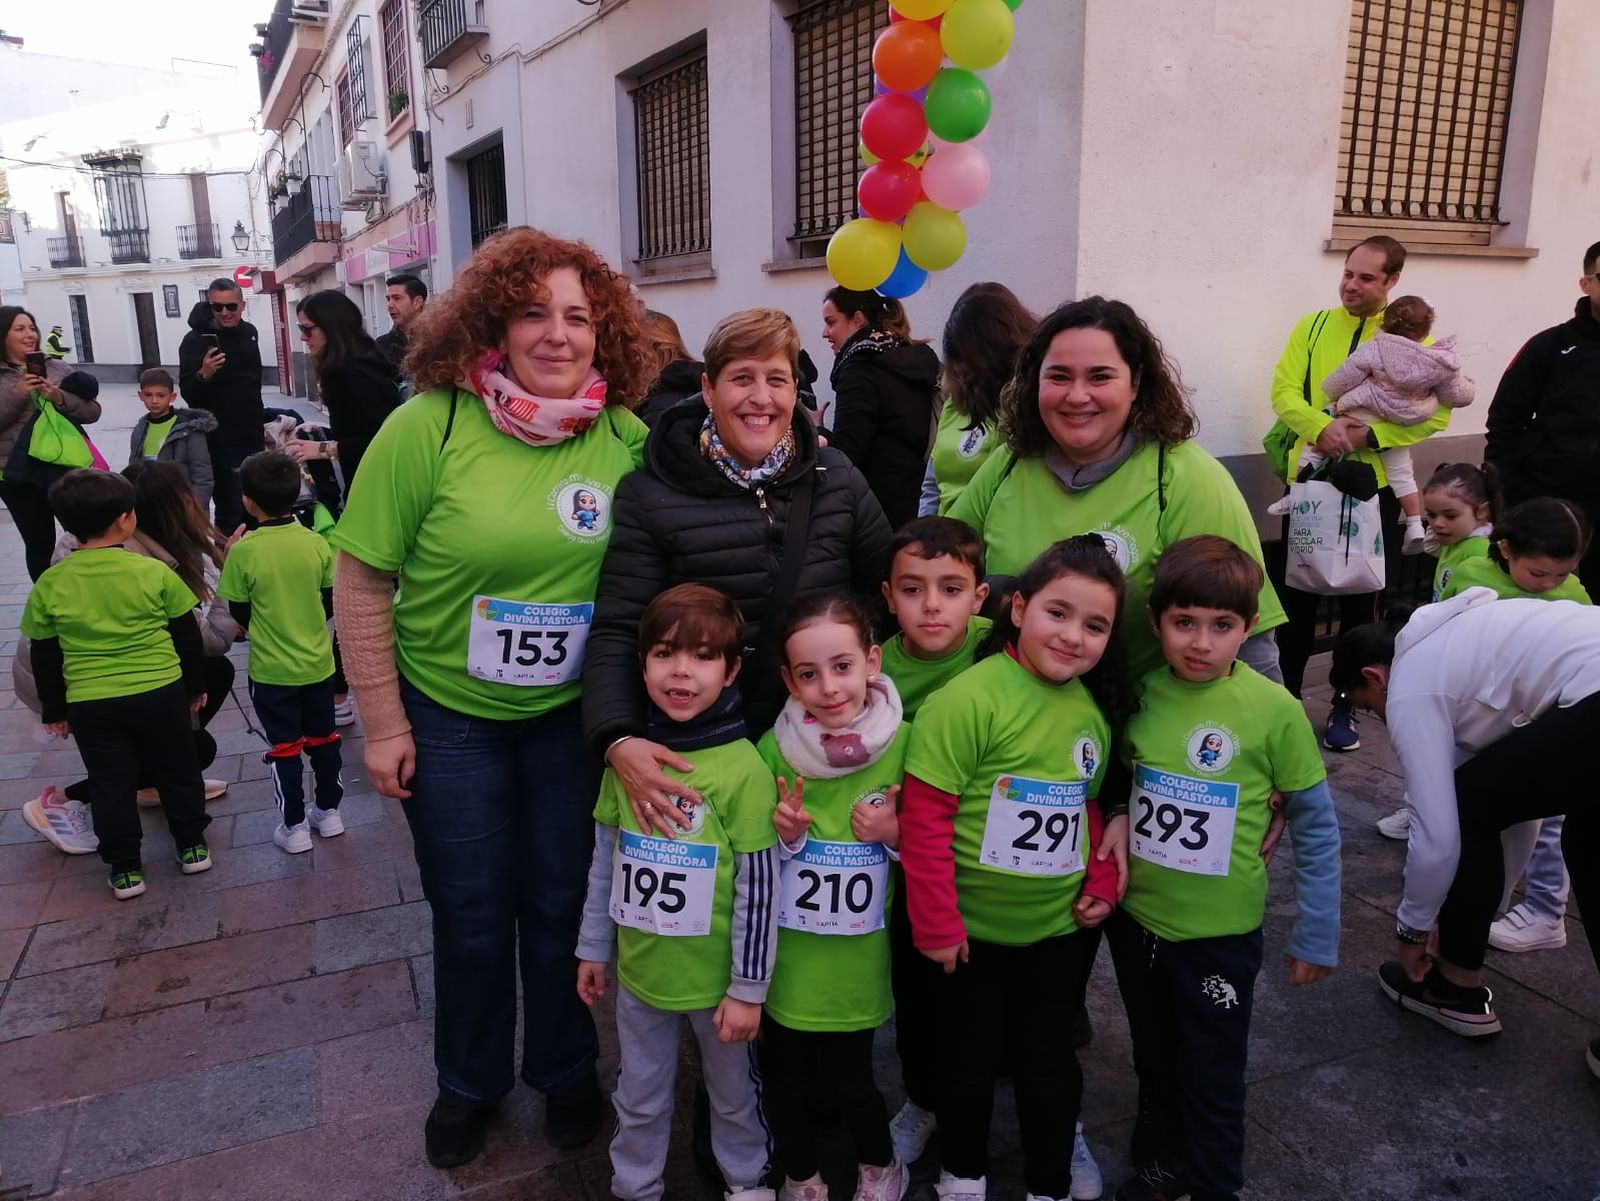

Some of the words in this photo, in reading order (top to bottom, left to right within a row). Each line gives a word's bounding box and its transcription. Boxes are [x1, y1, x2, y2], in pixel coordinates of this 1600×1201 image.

[1293, 528, 1312, 536] PARA
[503, 613, 540, 625] DIVINA
[541, 614, 585, 625] PASTORA
[524, 606, 571, 617] COLEGIO
[496, 629, 569, 667] 153
[1048, 785, 1084, 796] COLEGIO
[1159, 774, 1209, 793] COLEGIO
[1026, 792, 1062, 806] DIVINA
[1063, 795, 1086, 806] PASTO
[1143, 780, 1175, 798] DIVINA
[1176, 789, 1228, 806] PASTORA
[1011, 810, 1081, 853] 291
[1134, 795, 1211, 851] 293
[640, 839, 688, 855] COLEGIO
[824, 845, 873, 856] COLEGIO
[624, 845, 655, 862] DIVINA
[656, 852, 708, 868] PASTORA
[804, 852, 841, 866] DIVINA
[843, 854, 884, 867] PASTORA
[621, 863, 687, 914] 195
[795, 869, 874, 914] 210
